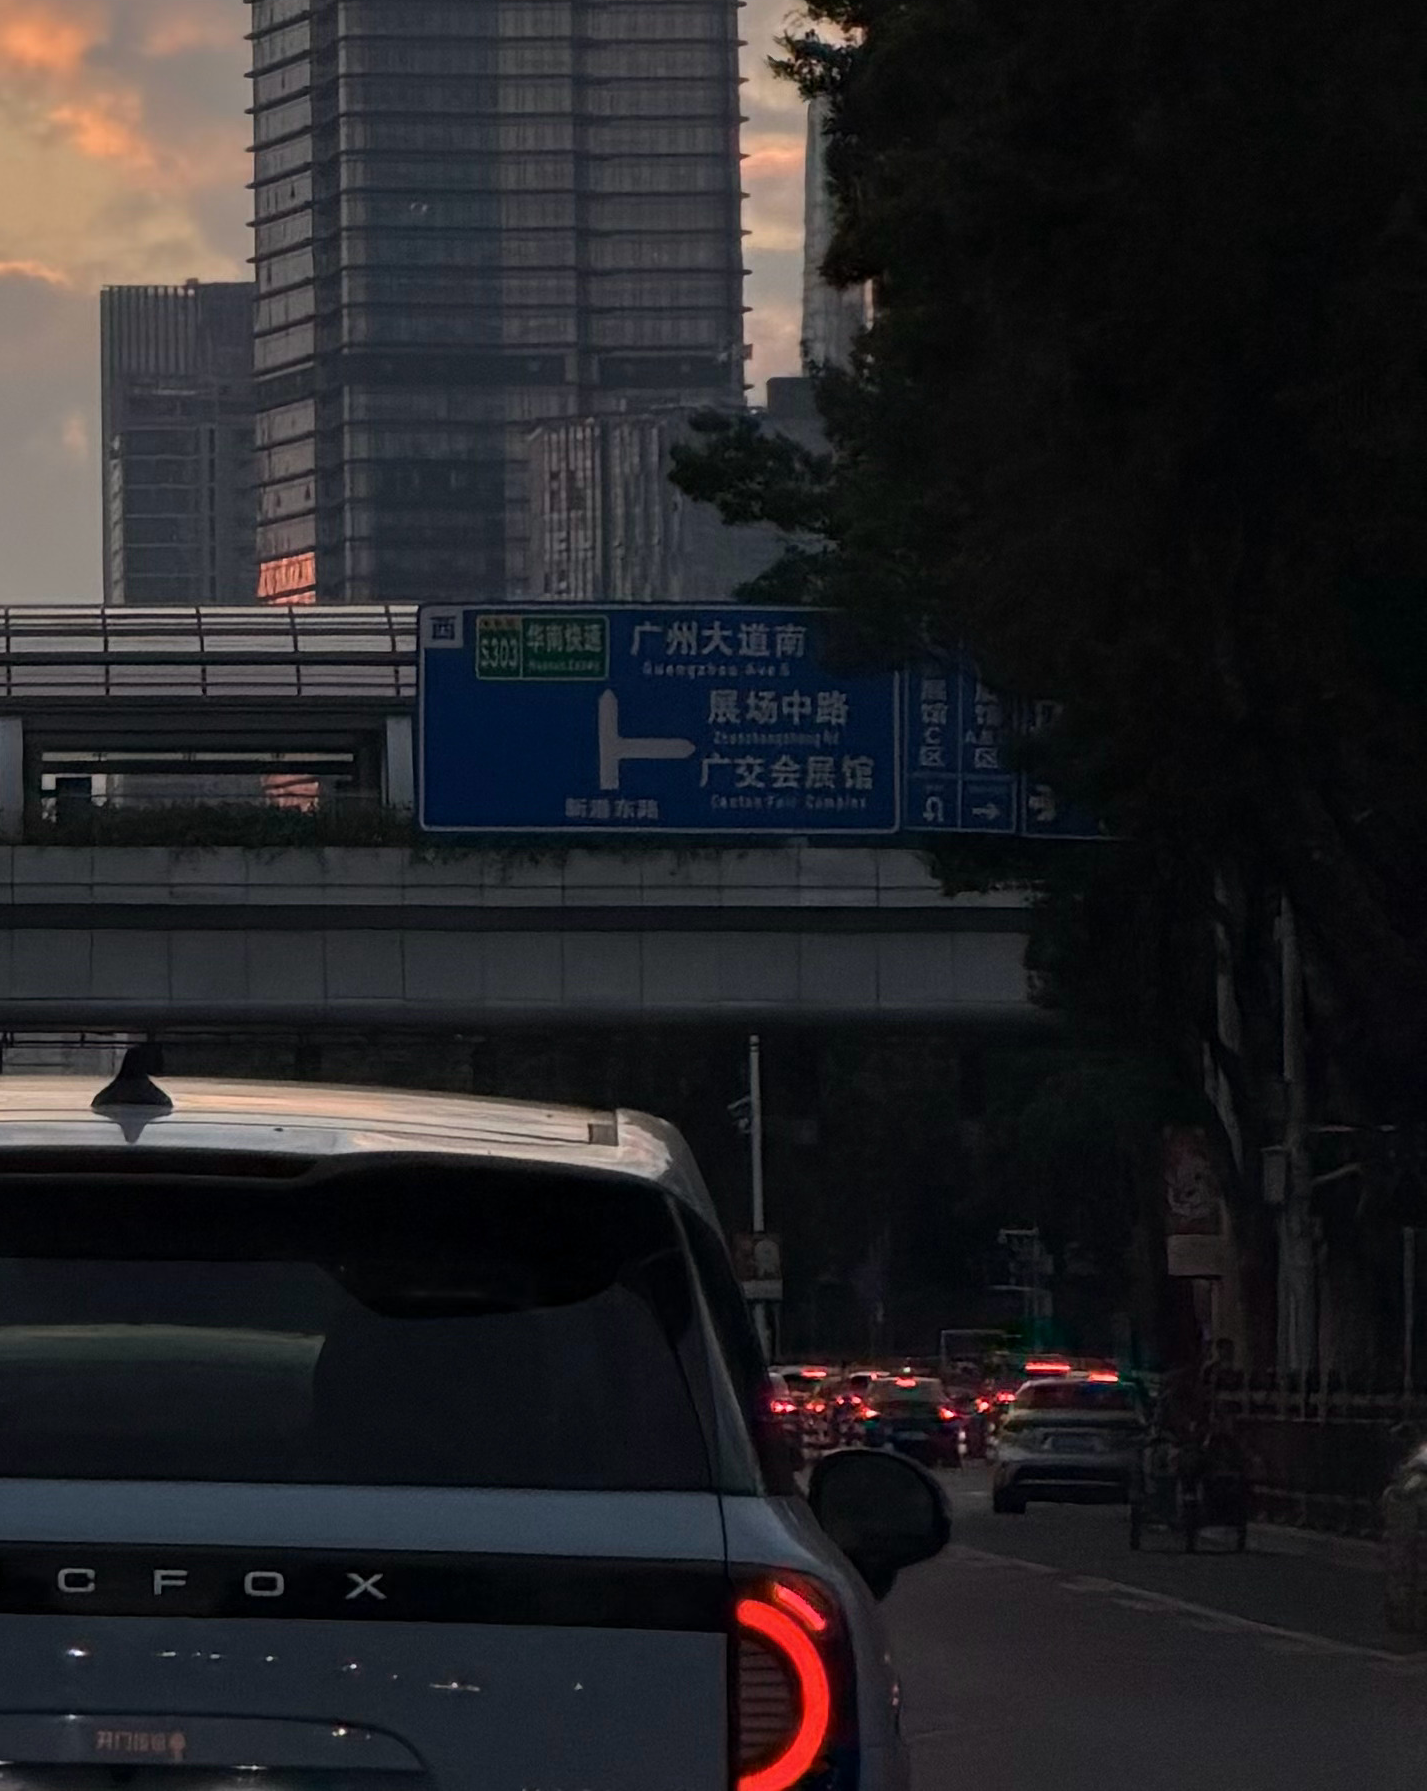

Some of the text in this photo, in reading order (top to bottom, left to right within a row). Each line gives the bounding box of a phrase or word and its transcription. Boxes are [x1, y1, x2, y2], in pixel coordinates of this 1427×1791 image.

[429, 615, 457, 640] 西
[629, 620, 808, 658] 广州大道南
[480, 637, 519, 668] S303
[707, 688, 850, 726] 展场中路
[699, 752, 875, 790] 广交会展馆
